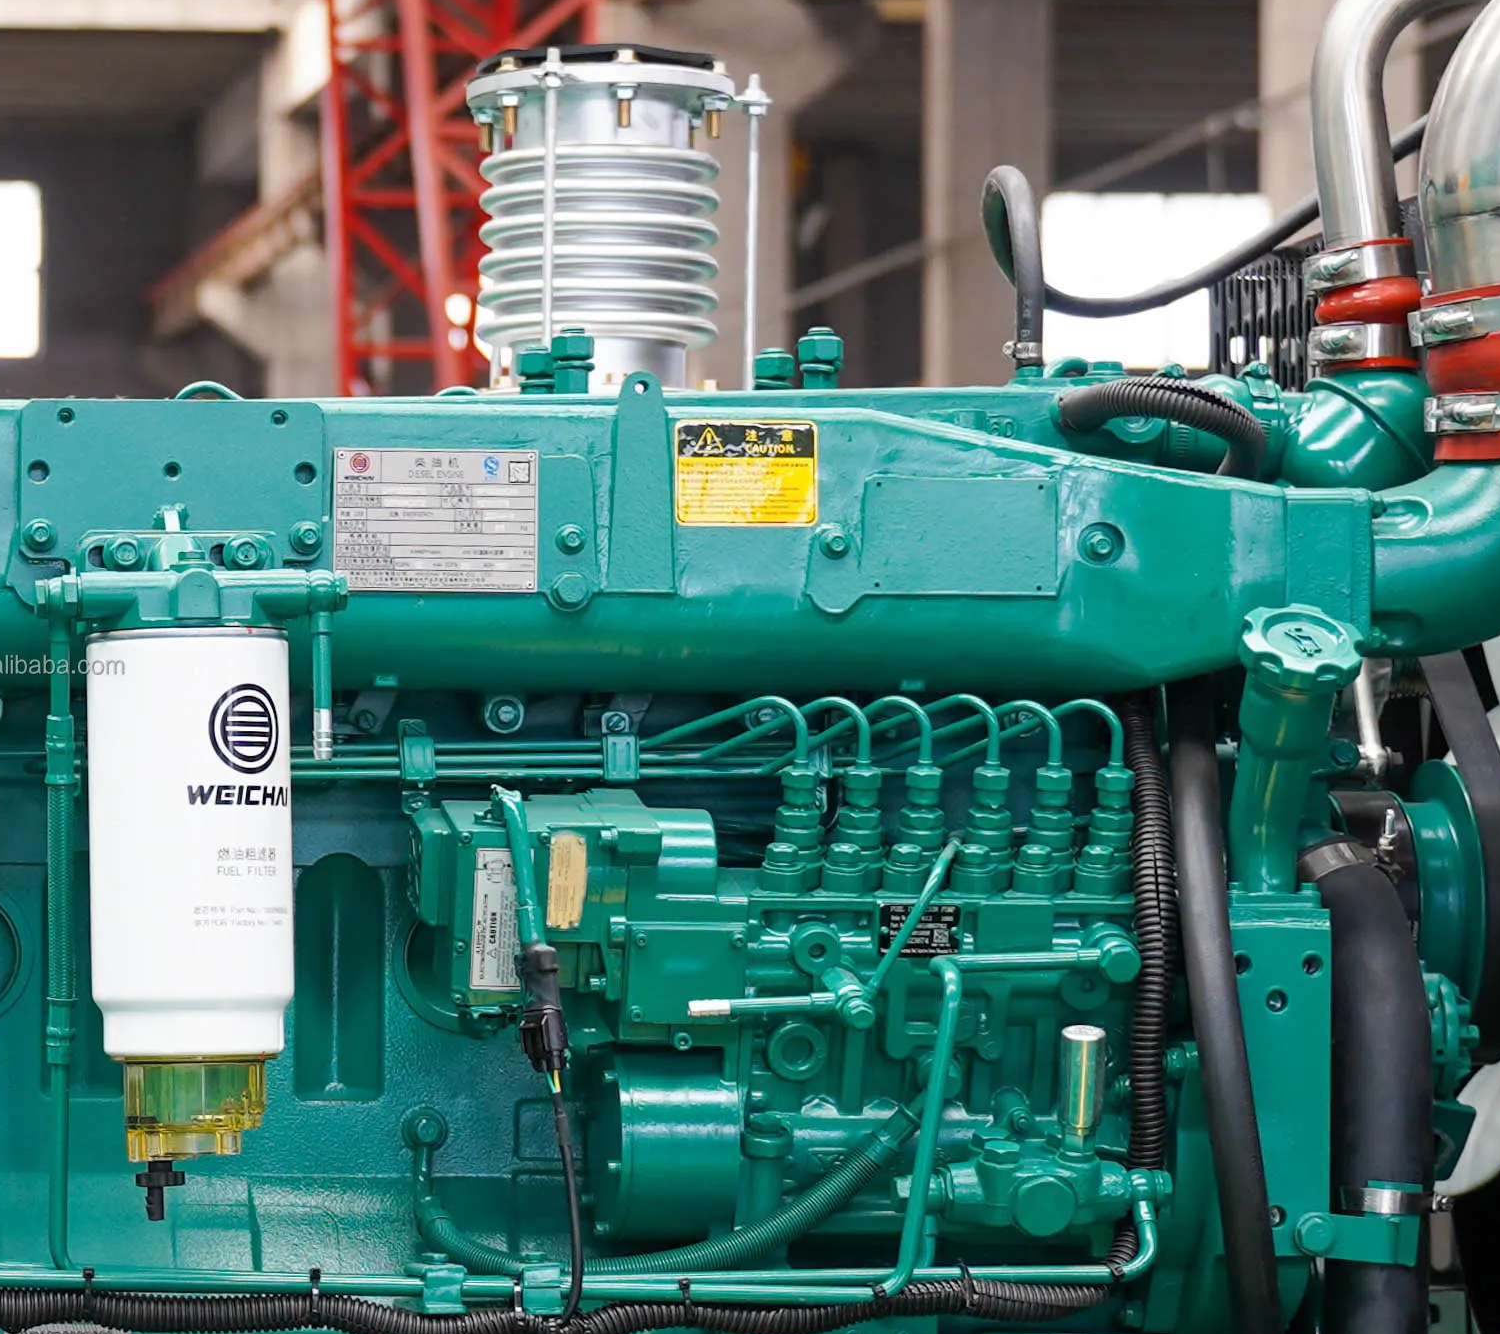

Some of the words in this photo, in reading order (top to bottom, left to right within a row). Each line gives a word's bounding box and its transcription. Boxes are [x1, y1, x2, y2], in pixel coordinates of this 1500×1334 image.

[745, 443, 796, 454] CAUTION
[436, 470, 466, 479] ENGINE
[187, 785, 288, 806] WEICHAI
[217, 866, 241, 876] FUEL
[247, 866, 277, 876] FILTER
[489, 911, 497, 944] CAUTION
